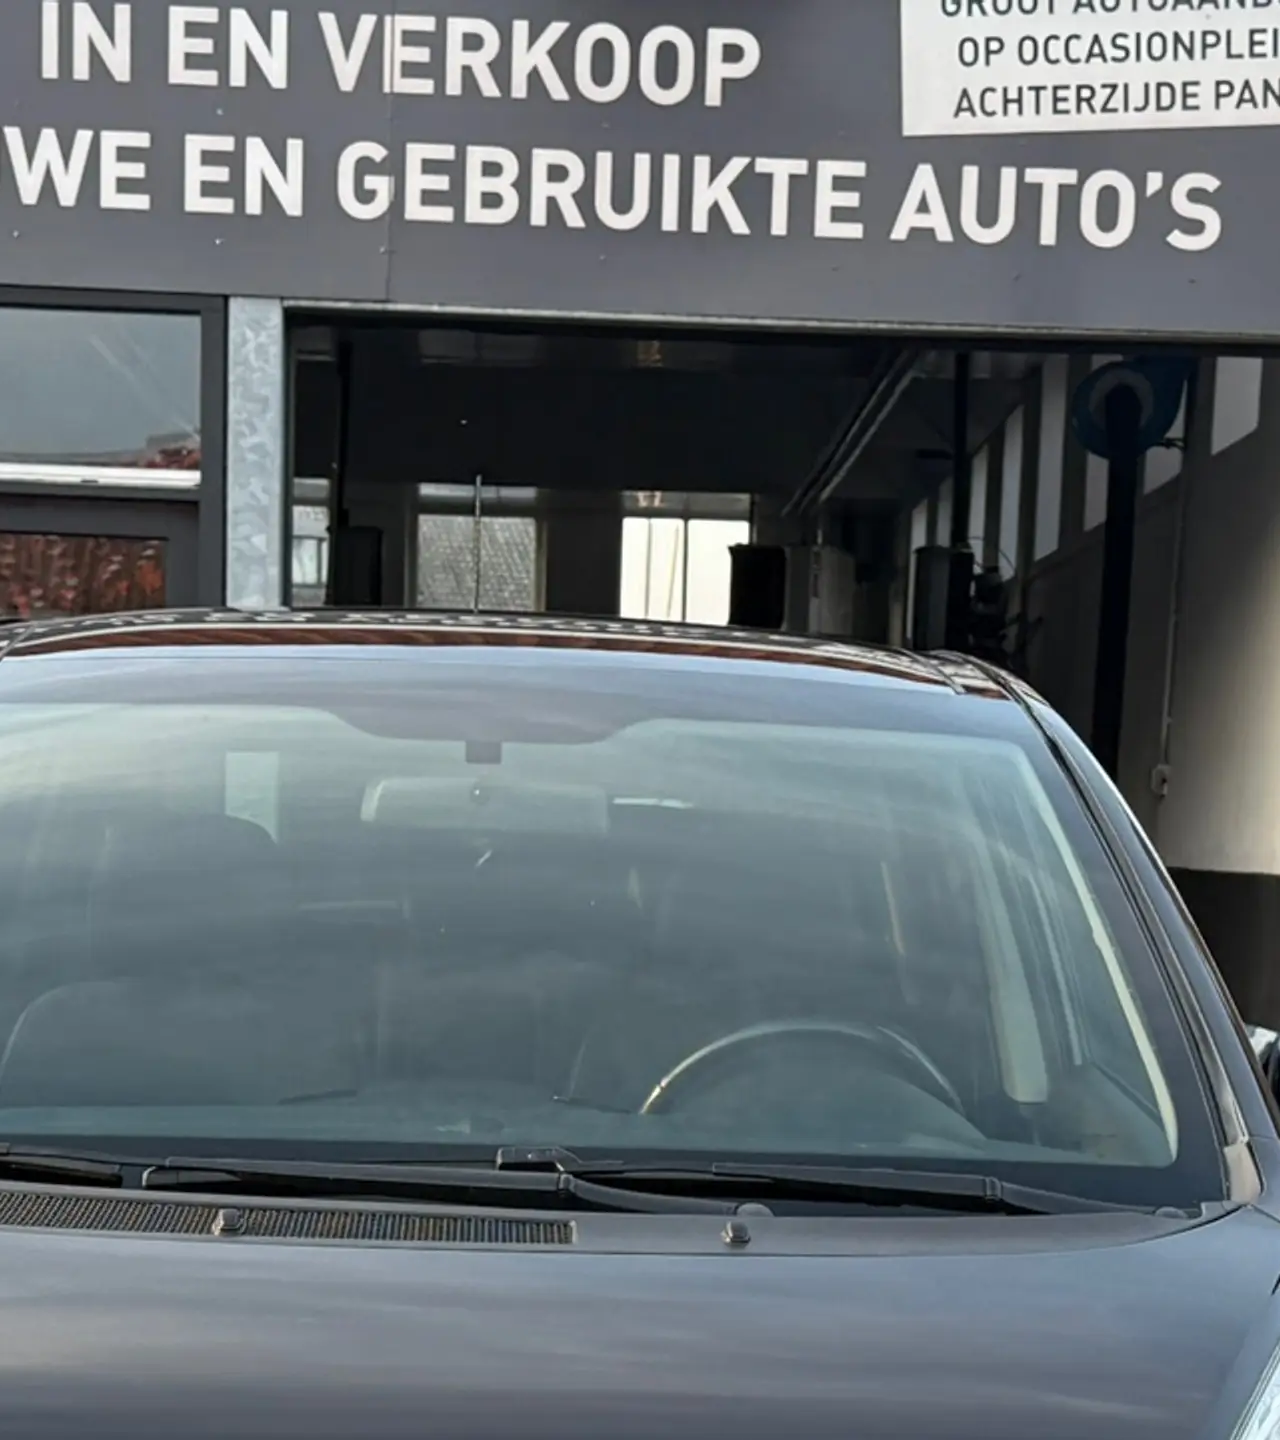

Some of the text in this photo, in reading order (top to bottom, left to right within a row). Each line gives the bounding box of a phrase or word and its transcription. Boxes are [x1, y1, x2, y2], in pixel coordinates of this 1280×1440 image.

[41, 0, 762, 107] IN EN VERKOOP
[957, 36, 1005, 67] OP
[953, 81, 1201, 118] ACHTERZIJDE
[183, 133, 304, 217] EN
[337, 140, 868, 239] GEBRUIKTE
[889, 163, 1223, 251] AUTO'S
